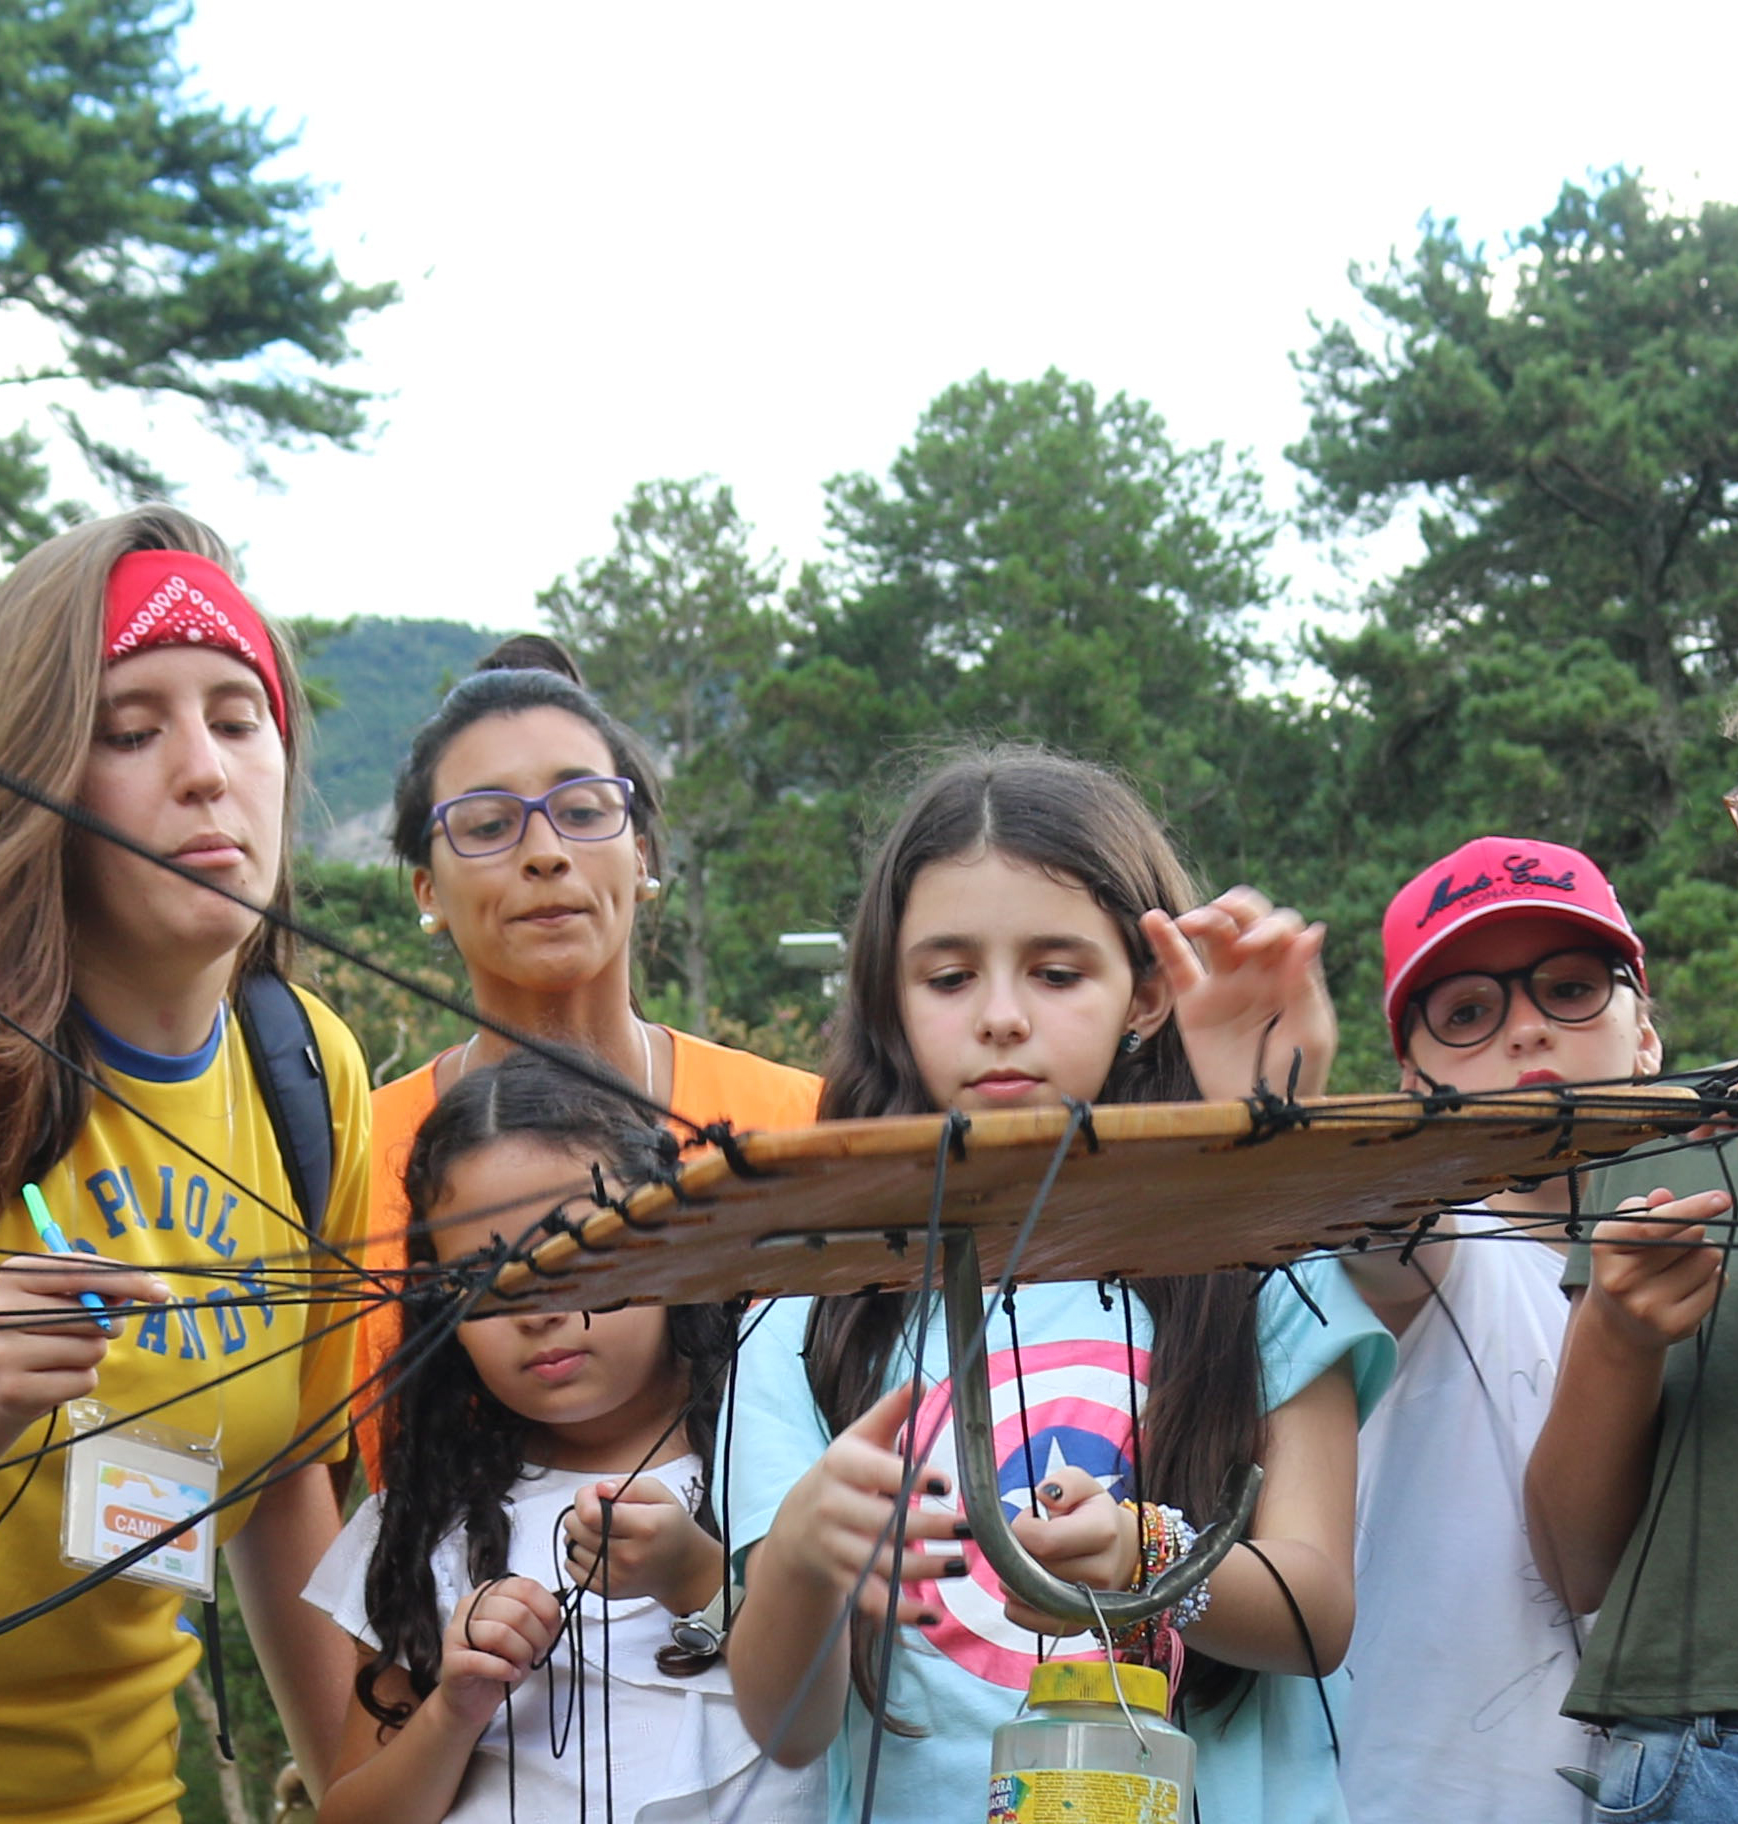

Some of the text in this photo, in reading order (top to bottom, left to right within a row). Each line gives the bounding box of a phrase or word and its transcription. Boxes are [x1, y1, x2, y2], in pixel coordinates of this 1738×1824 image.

[1461, 886, 1534, 908] MONACO
[69, 1237, 274, 1360] ANDE
[115, 1514, 180, 1545] CAMI
